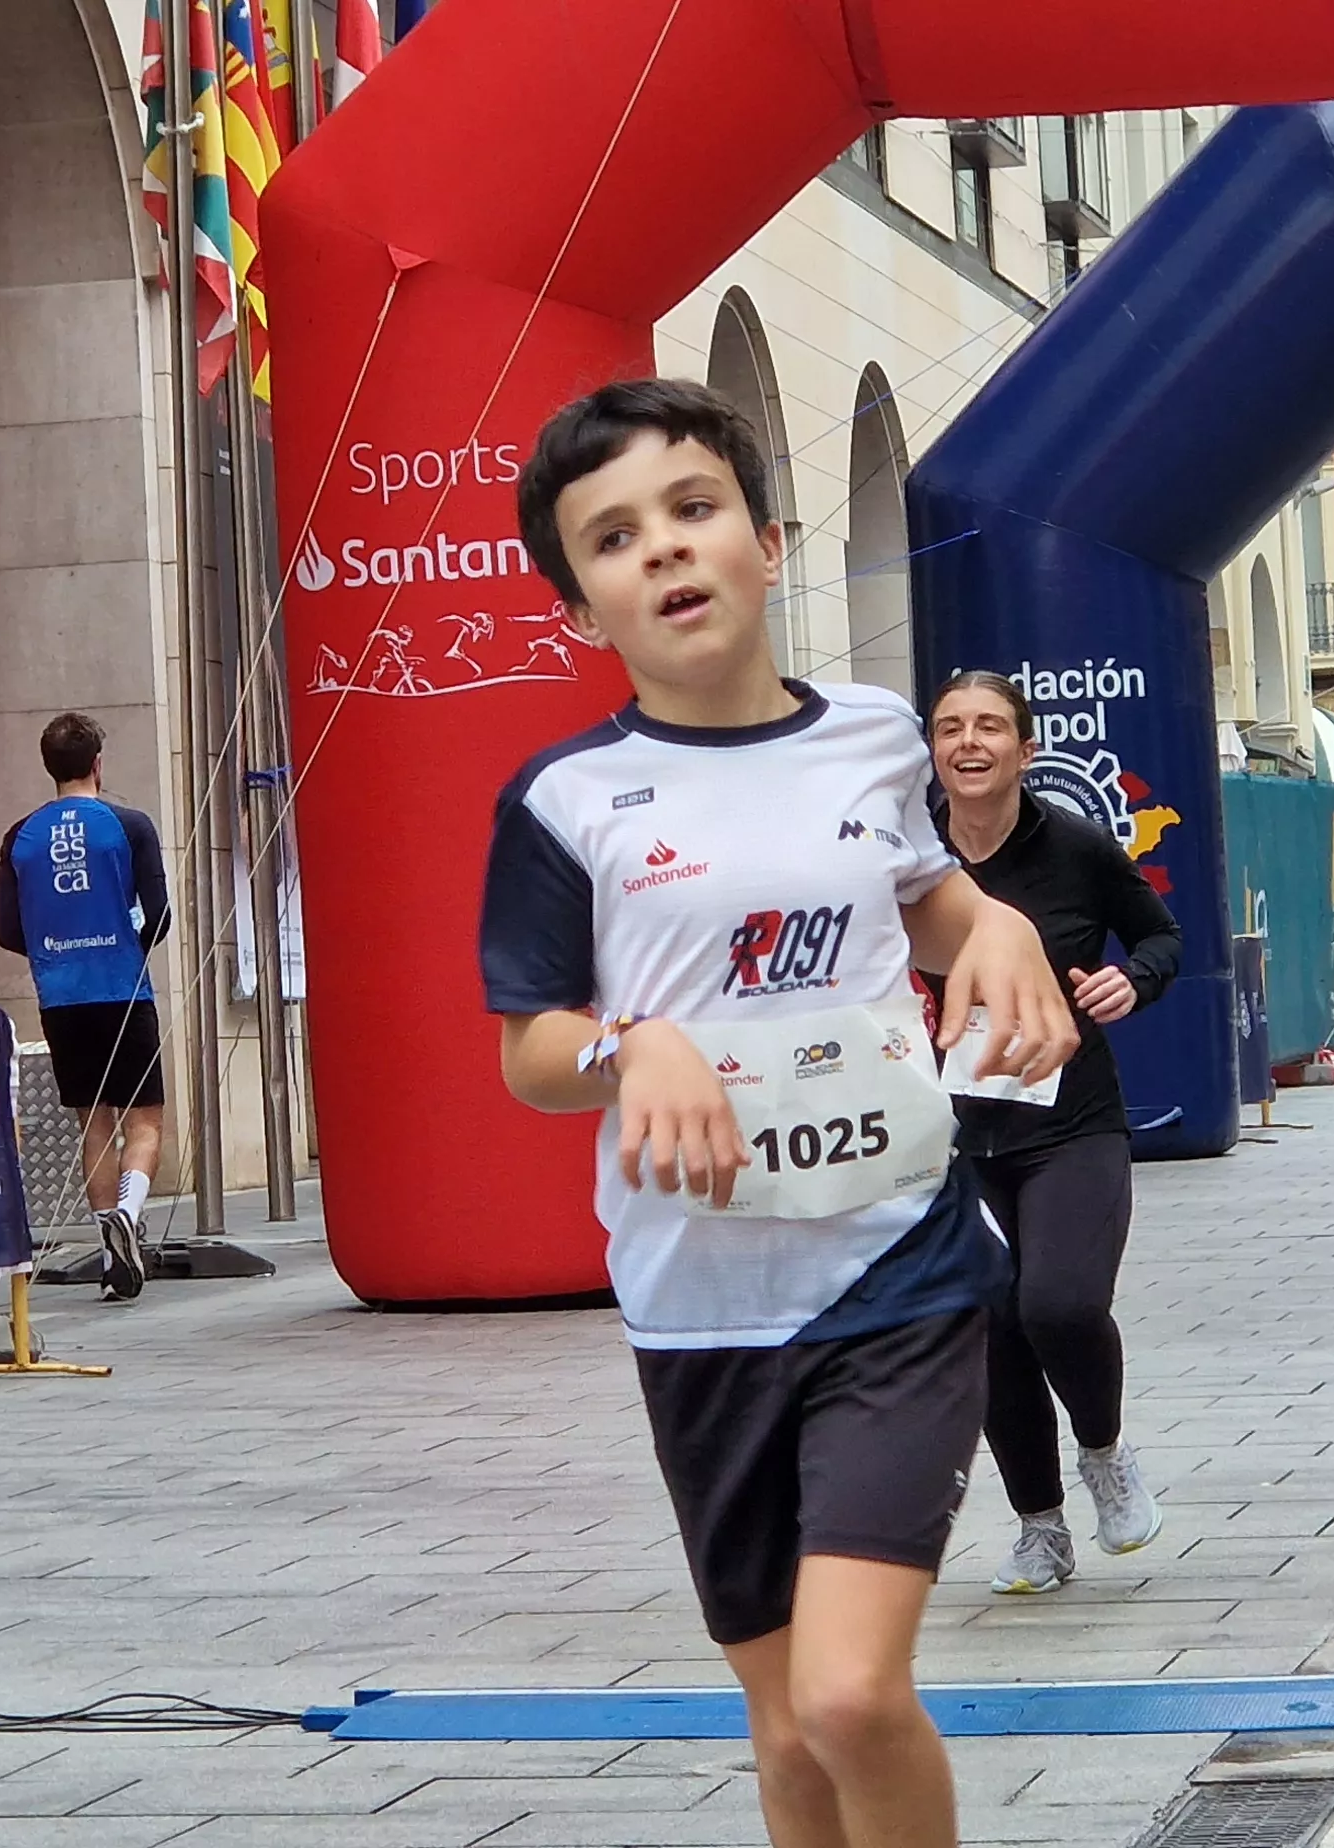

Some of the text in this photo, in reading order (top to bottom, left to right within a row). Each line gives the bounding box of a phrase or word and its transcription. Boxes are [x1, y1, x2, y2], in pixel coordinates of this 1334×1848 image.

[349, 438, 520, 505] Sports
[342, 533, 530, 588] Santan
[1008, 657, 1147, 701] dación
[1033, 701, 1107, 750] pol
[1042, 775, 1100, 812] Mutualidad
[622, 861, 711, 896] Santander
[719, 1073, 765, 1088] tander
[751, 1109, 890, 1173] 1025
